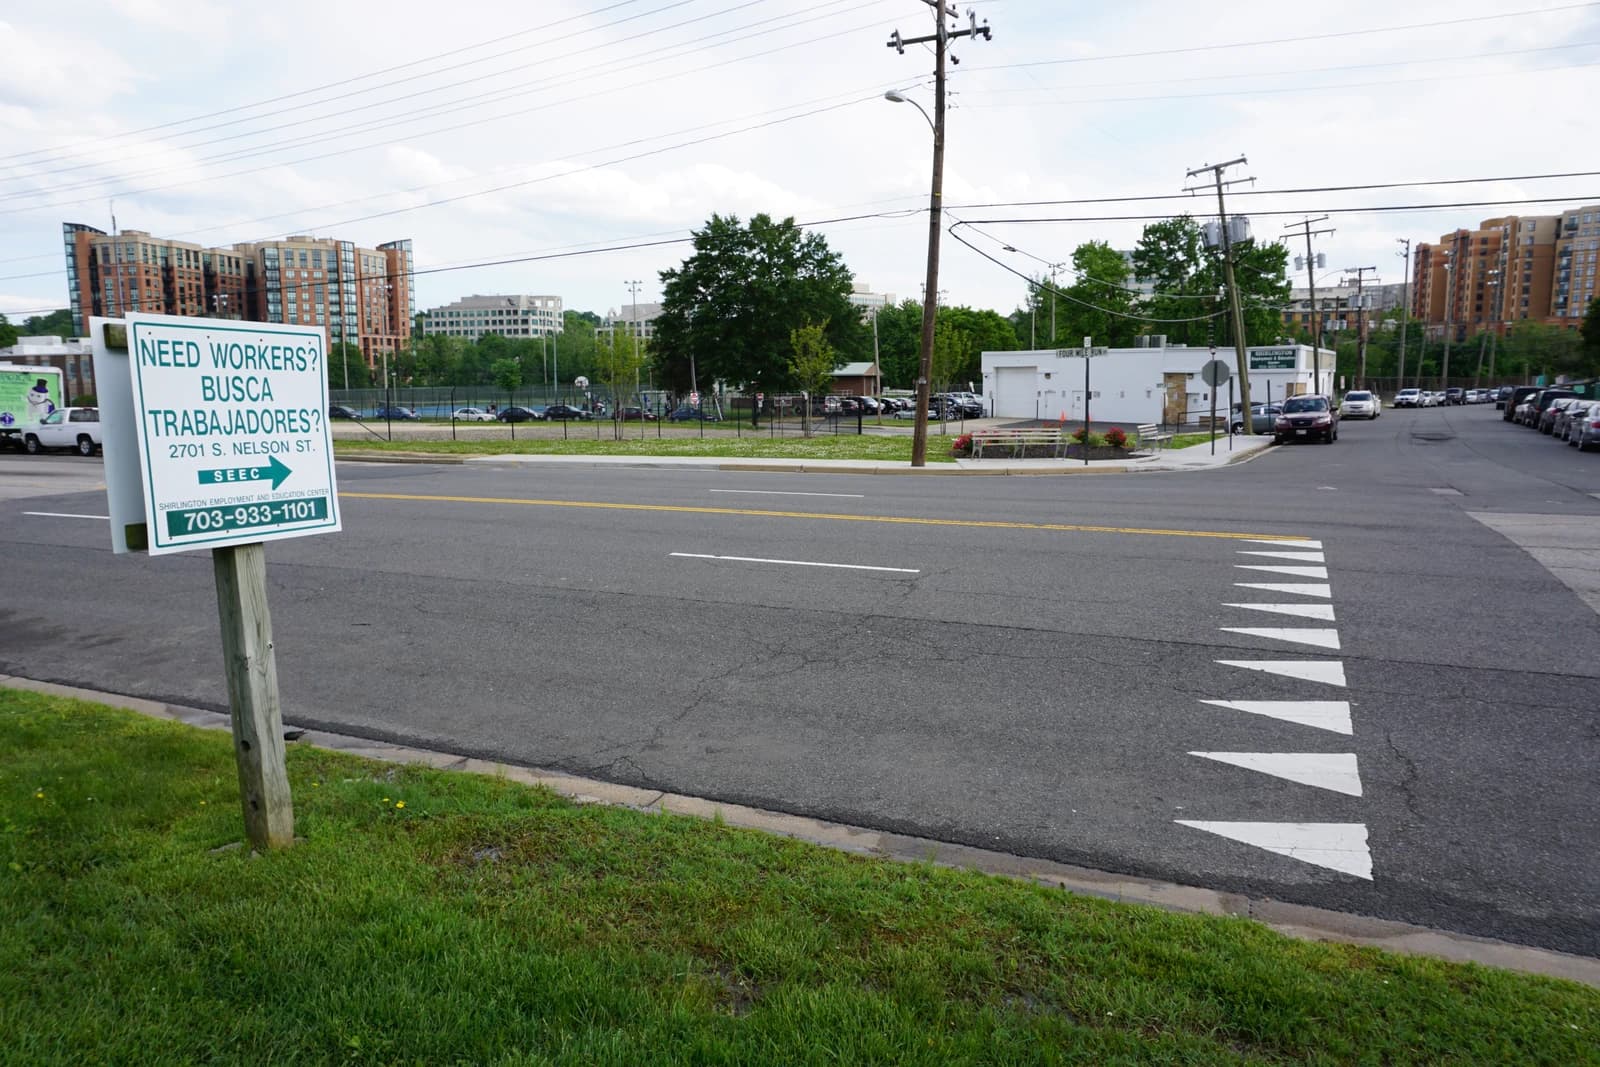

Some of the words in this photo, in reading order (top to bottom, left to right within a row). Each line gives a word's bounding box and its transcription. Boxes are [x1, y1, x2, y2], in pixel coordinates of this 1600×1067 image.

[140, 339, 200, 367] NEED
[209, 342, 318, 371] WORKERS?
[201, 375, 274, 402] BUSCA
[148, 409, 321, 437] TRABAJADORES?
[169, 444, 205, 458] 2701
[212, 443, 226, 456] S.
[232, 441, 290, 455] NELSON
[296, 440, 316, 452] ST.
[214, 468, 260, 482] SEEC
[159, 500, 208, 511] SHIRLINGTON
[209, 495, 254, 506] EMPLOYMENT
[257, 493, 270, 502] AND
[272, 490, 306, 500] EDUCATION
[307, 488, 329, 497] CENTER
[184, 501, 316, 531] 703-933-1101
